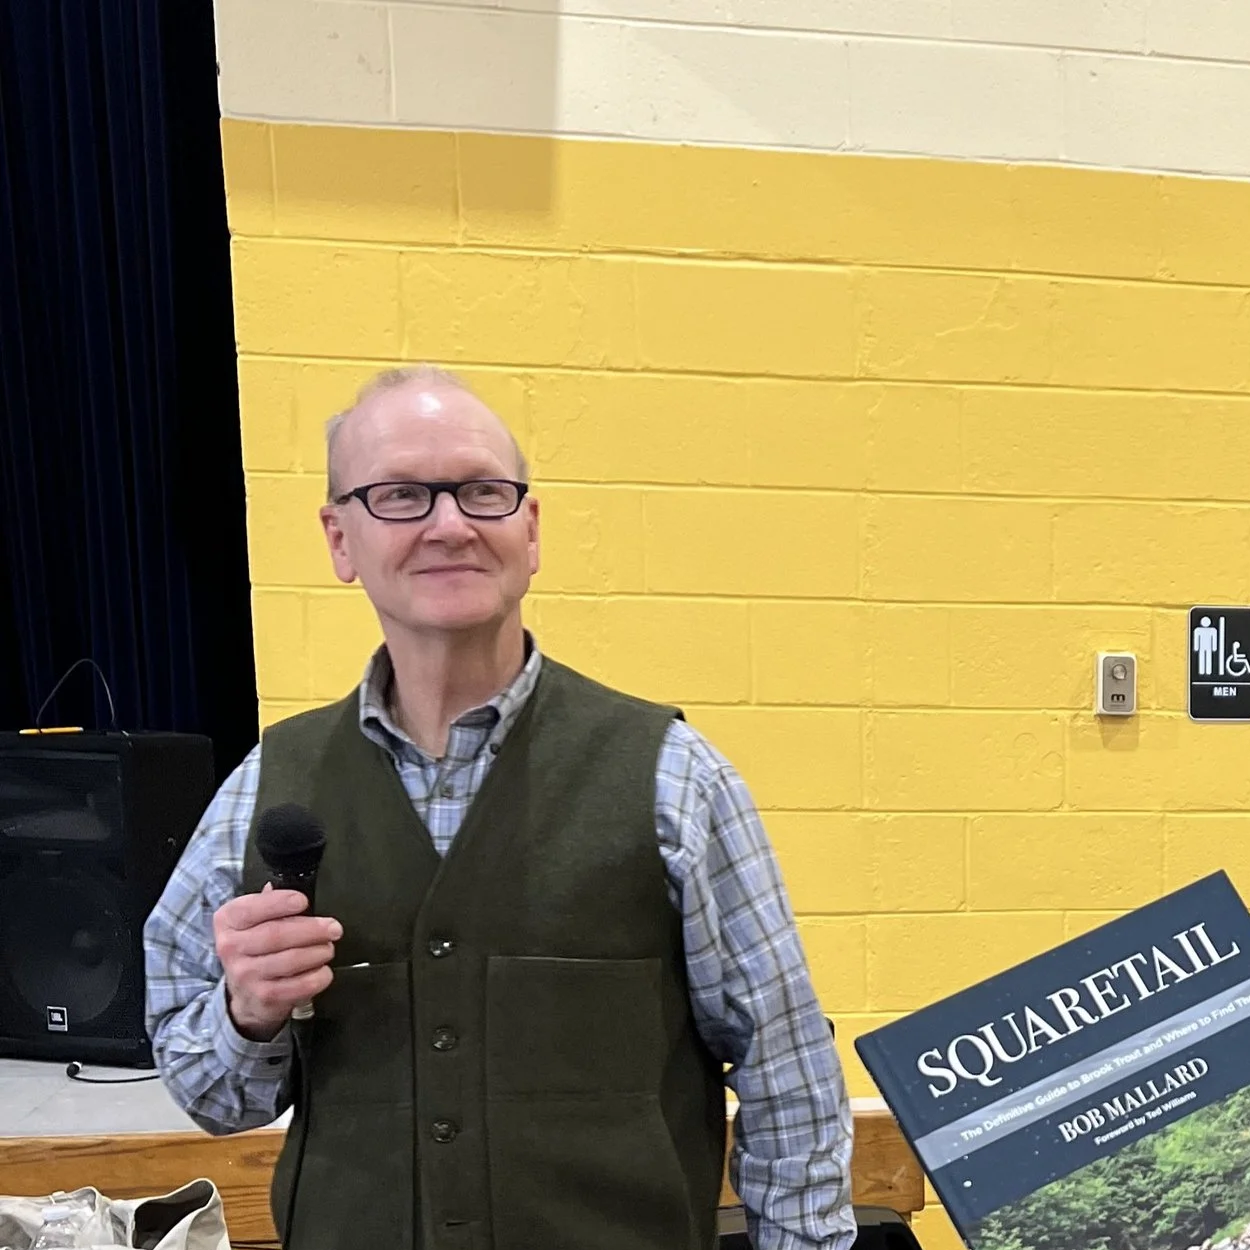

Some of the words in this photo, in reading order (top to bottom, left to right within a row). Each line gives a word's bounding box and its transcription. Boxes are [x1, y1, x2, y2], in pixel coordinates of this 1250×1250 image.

[1212, 686, 1237, 697] MEN
[916, 922, 1241, 1098] SQUARETAIL
[960, 1125, 983, 1141] The
[982, 1101, 1035, 1131] Definitive
[1034, 1085, 1067, 1106] Guide
[1067, 1080, 1080, 1091] to
[1079, 1063, 1113, 1084] Brook
[1113, 1048, 1142, 1068] Trout
[1143, 1036, 1164, 1054] and
[1162, 1021, 1198, 1044] Where
[1198, 1015, 1212, 1026] to
[1211, 1001, 1236, 1020] Find
[1057, 1107, 1106, 1143] BOB
[1102, 1057, 1209, 1121] MALLARD
[1133, 1115, 1146, 1126] by
[1145, 1106, 1163, 1120] Ted
[1160, 1091, 1197, 1112] Williams
